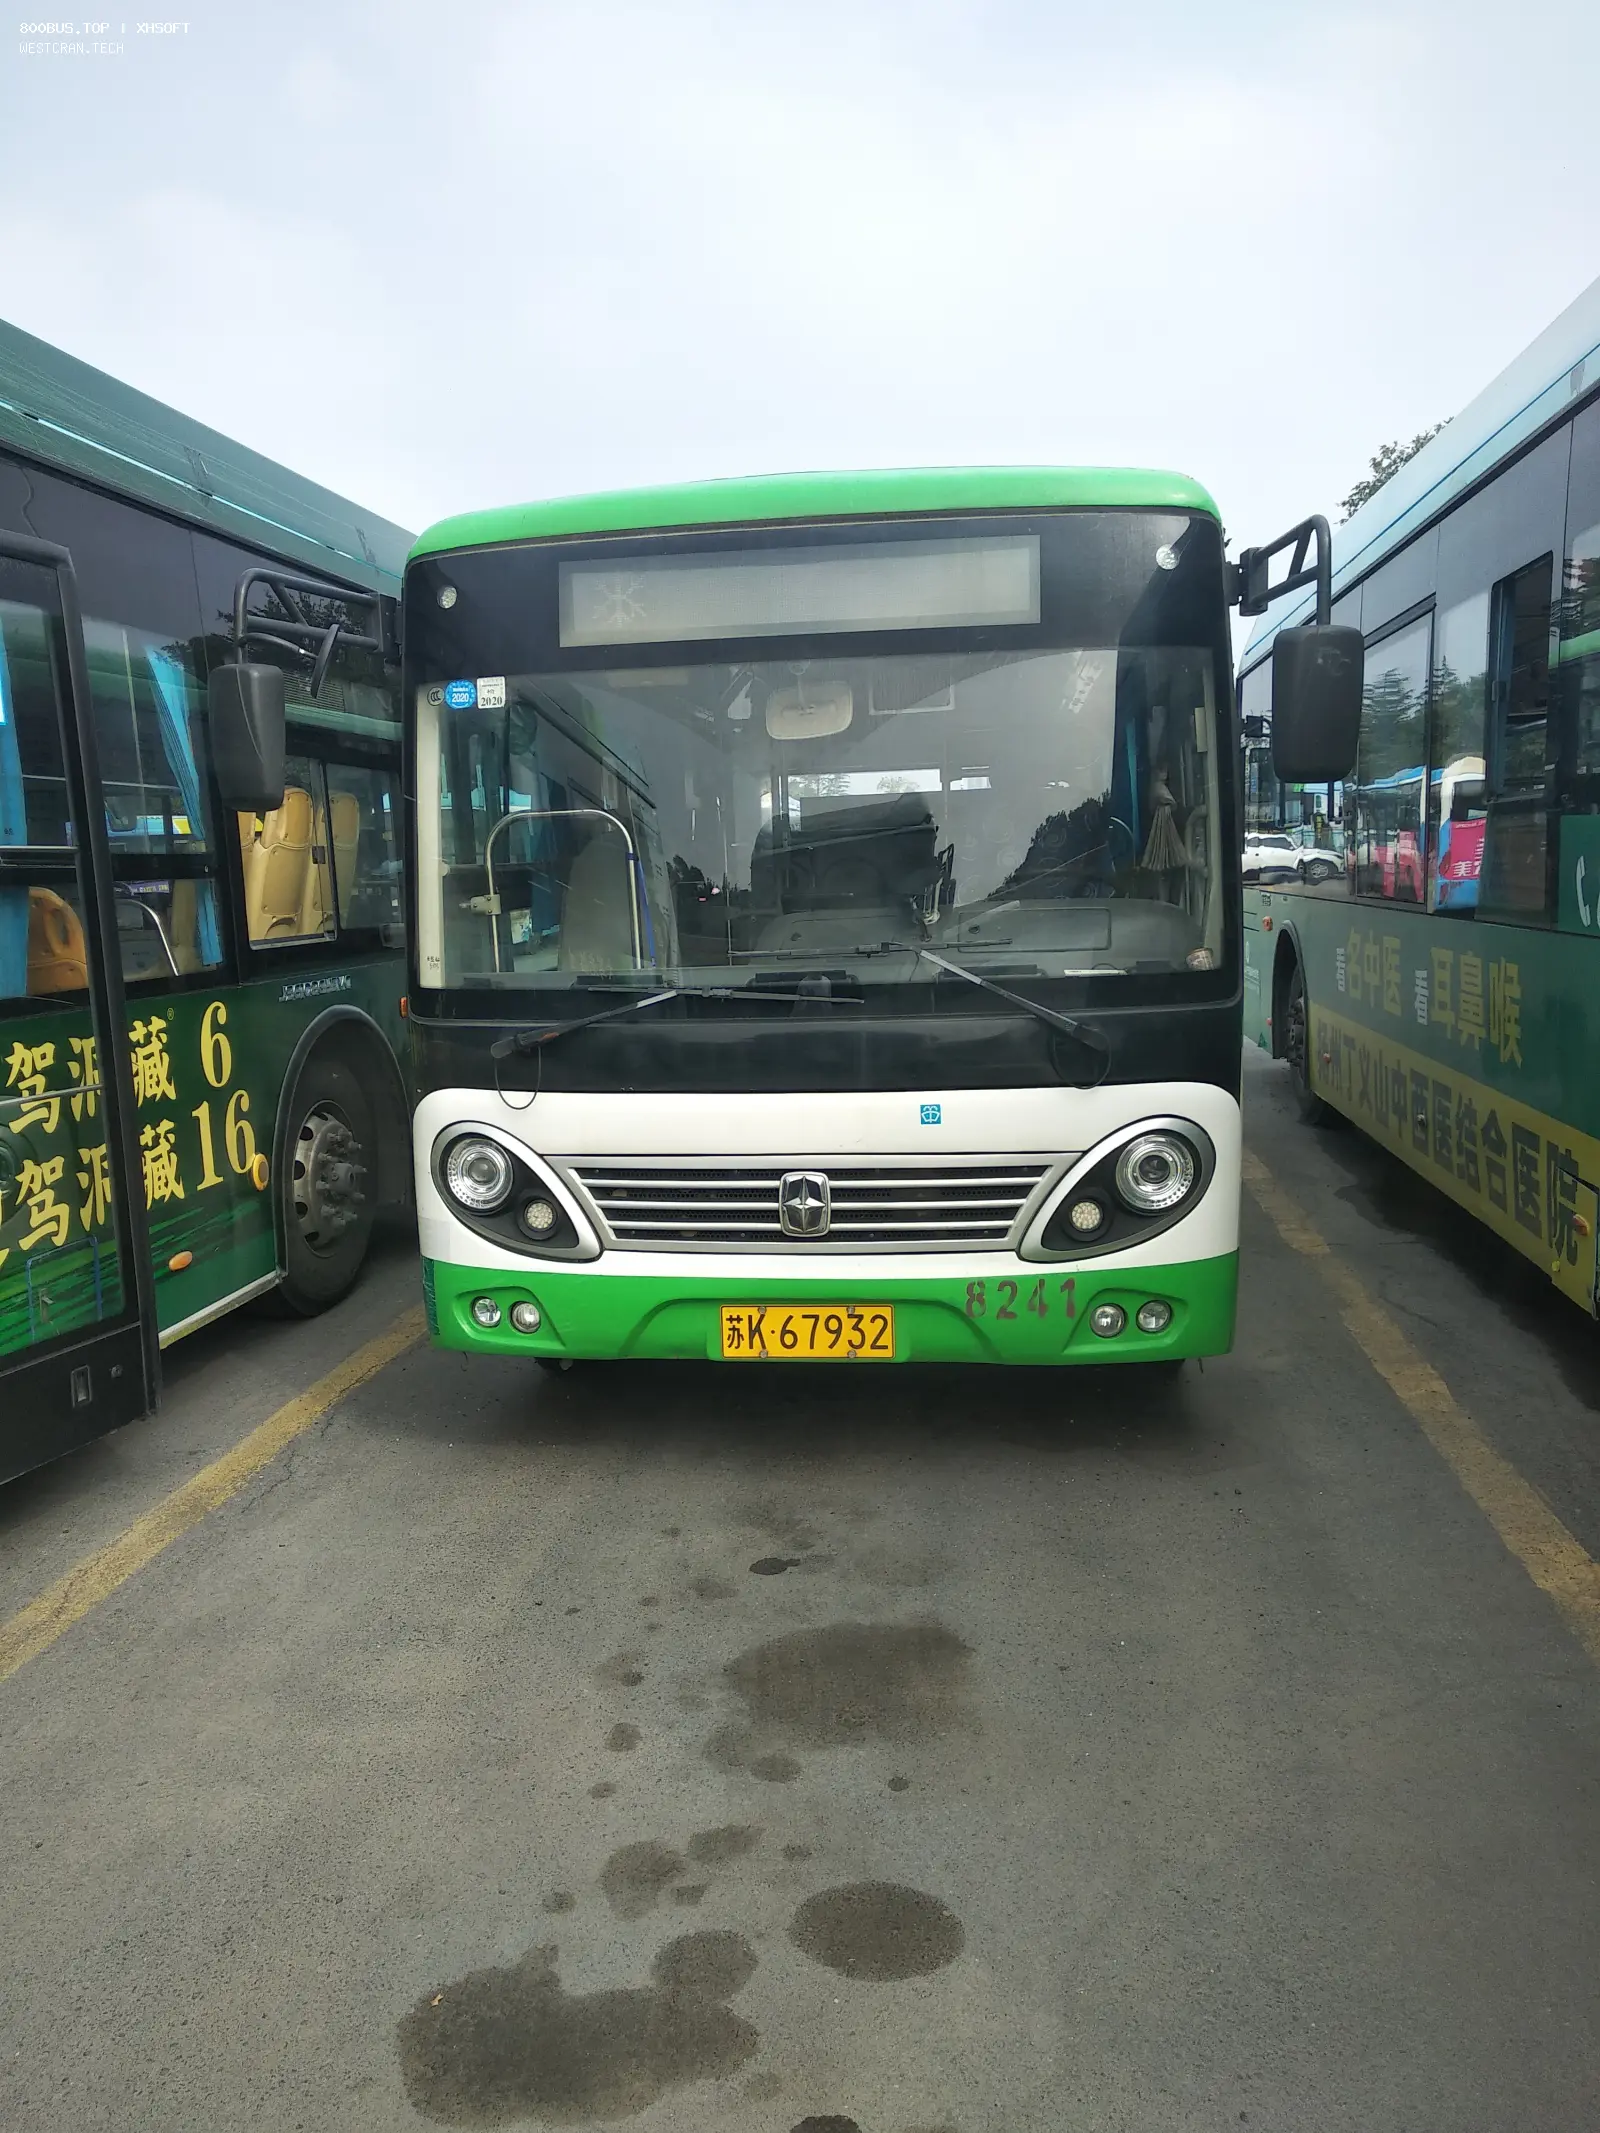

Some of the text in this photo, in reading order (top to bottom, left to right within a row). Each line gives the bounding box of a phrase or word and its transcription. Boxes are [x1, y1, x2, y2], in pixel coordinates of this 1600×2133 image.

[451, 692, 470, 703] 2020
[480, 696, 503, 707] 2020
[200, 1001, 233, 1088] 6
[191, 1089, 257, 1192] 16
[964, 1277, 1077, 1320] 8241
